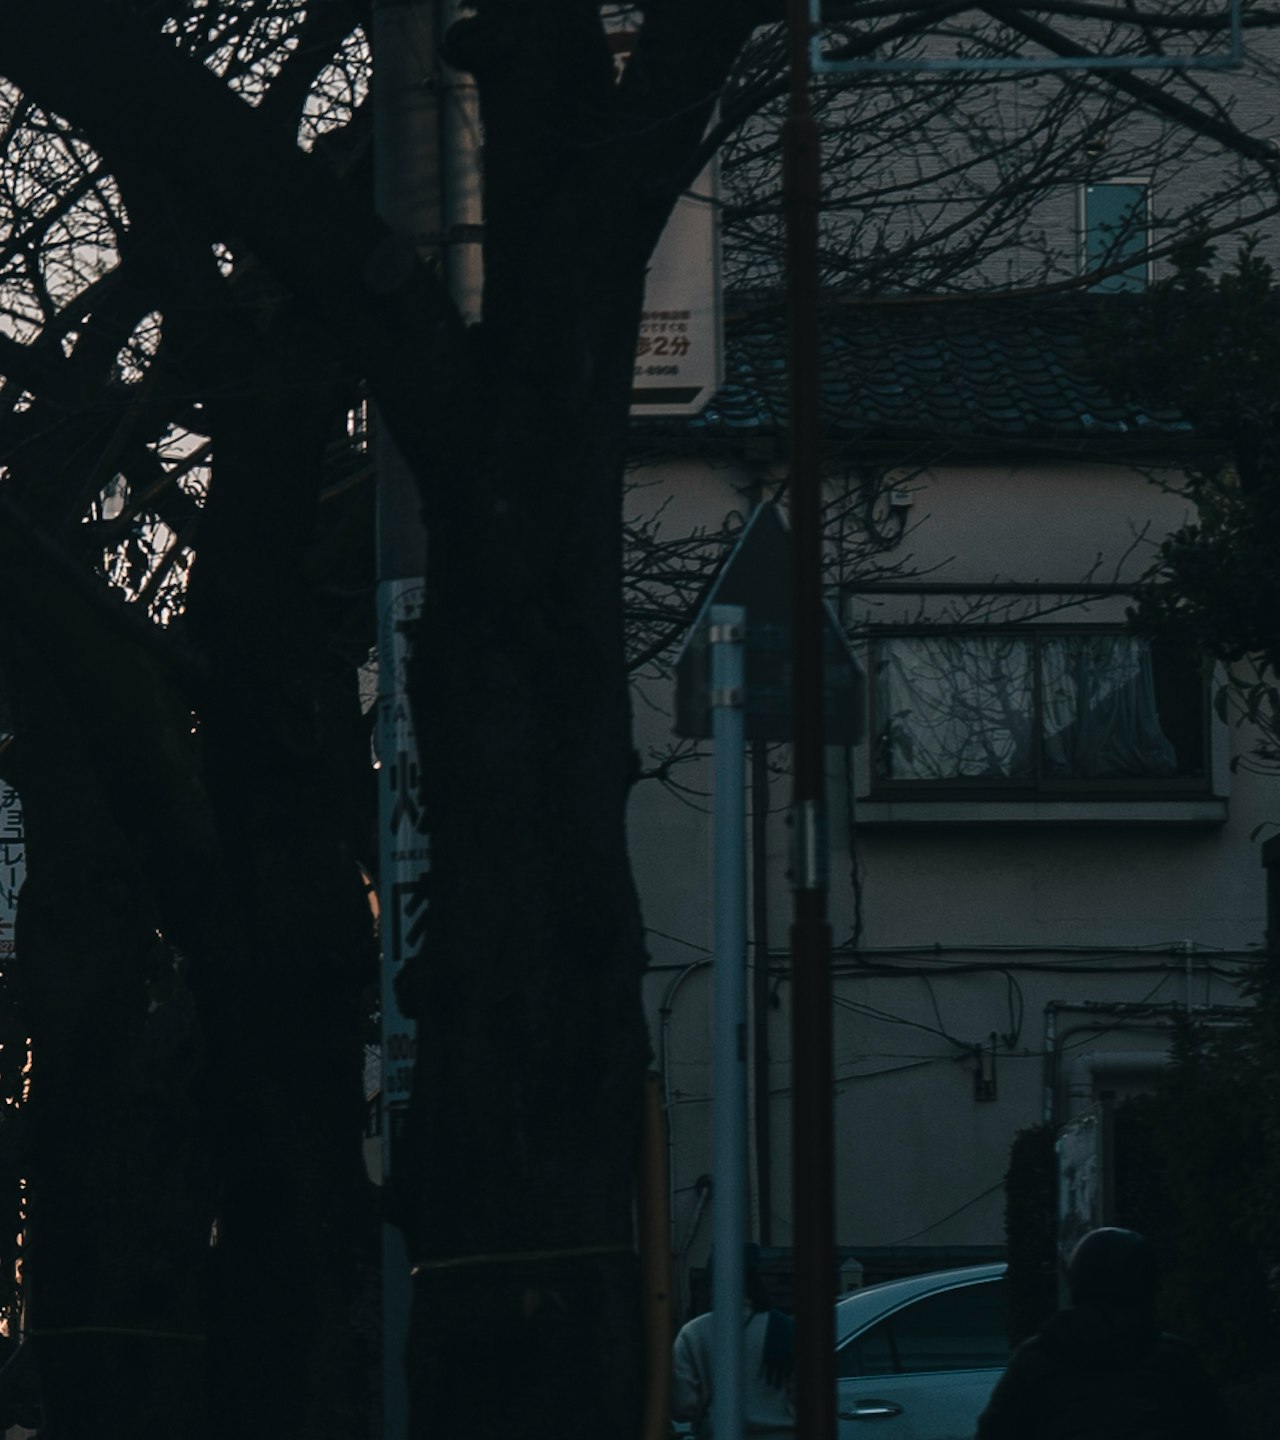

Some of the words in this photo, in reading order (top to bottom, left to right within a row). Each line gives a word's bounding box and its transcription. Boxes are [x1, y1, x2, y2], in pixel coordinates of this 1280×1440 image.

[3, 789, 23, 911] チョコレート
